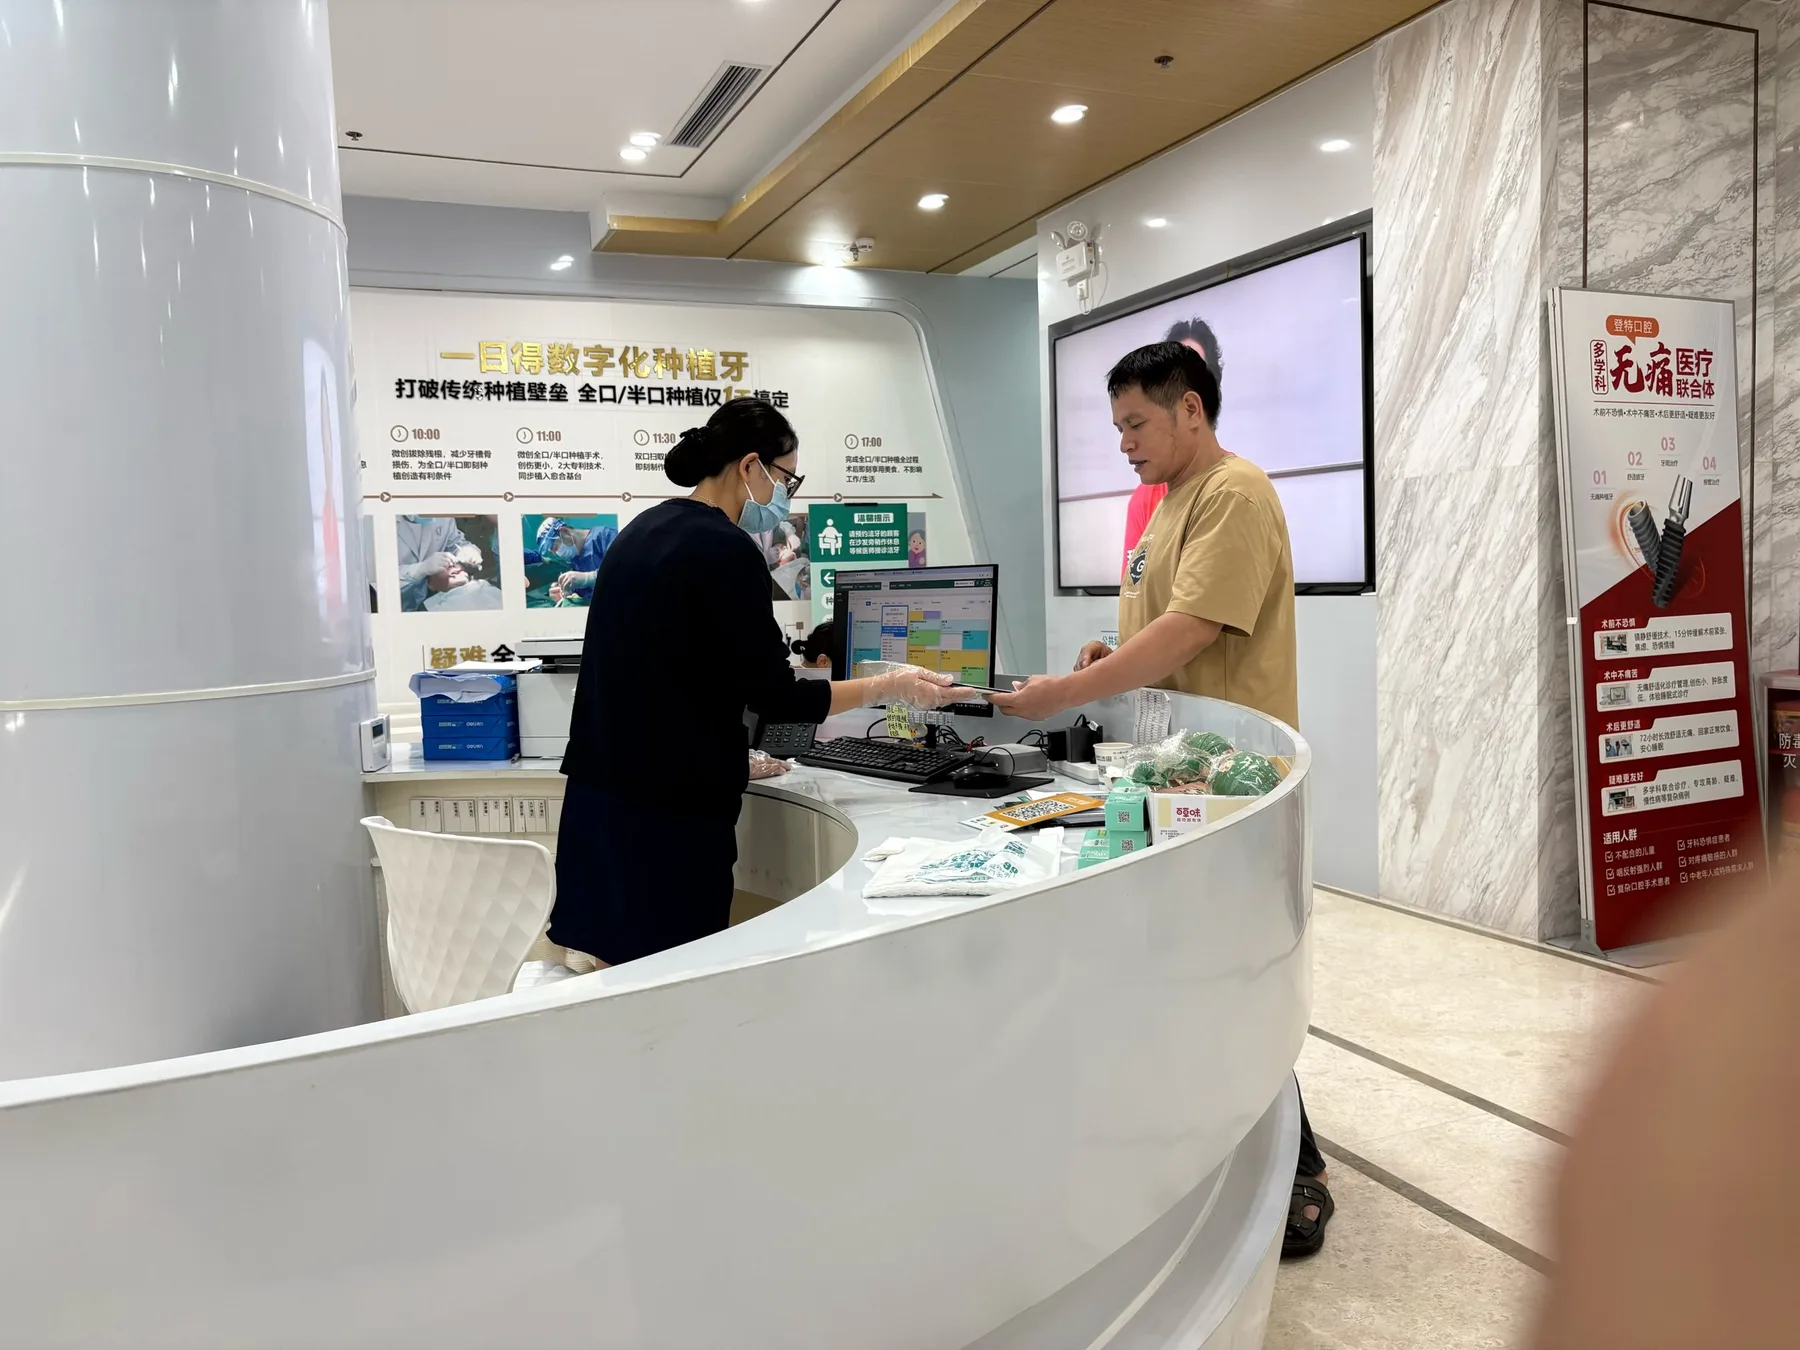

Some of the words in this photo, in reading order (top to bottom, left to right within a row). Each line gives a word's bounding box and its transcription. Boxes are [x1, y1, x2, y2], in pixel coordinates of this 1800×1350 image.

[1614, 319, 1652, 333] 登特口腔
[440, 341, 749, 382] 一日得数字化种植牙
[1593, 342, 1606, 391] 多学科
[1676, 348, 1713, 378] 医疗
[1610, 341, 1673, 397] 无痛
[395, 378, 568, 402] 打破传统种植壁垒
[1676, 378, 1714, 399] 联合体
[411, 428, 440, 440] 10:00
[536, 430, 561, 442] 11:00
[653, 432, 676, 444] 11:30
[861, 437, 882, 447] 17:00
[1661, 437, 1676, 451] 03
[1628, 451, 1643, 466] 02
[1702, 456, 1717, 470] 04
[1593, 469, 1607, 484] 01
[1603, 669, 1638, 680] 术中不痛苦
[1606, 719, 1641, 732] 术后更舒适
[1609, 772, 1644, 785] 疑难更友好
[1603, 828, 1638, 845] 适用人群
[1615, 846, 1655, 860] 不配合的儿童
